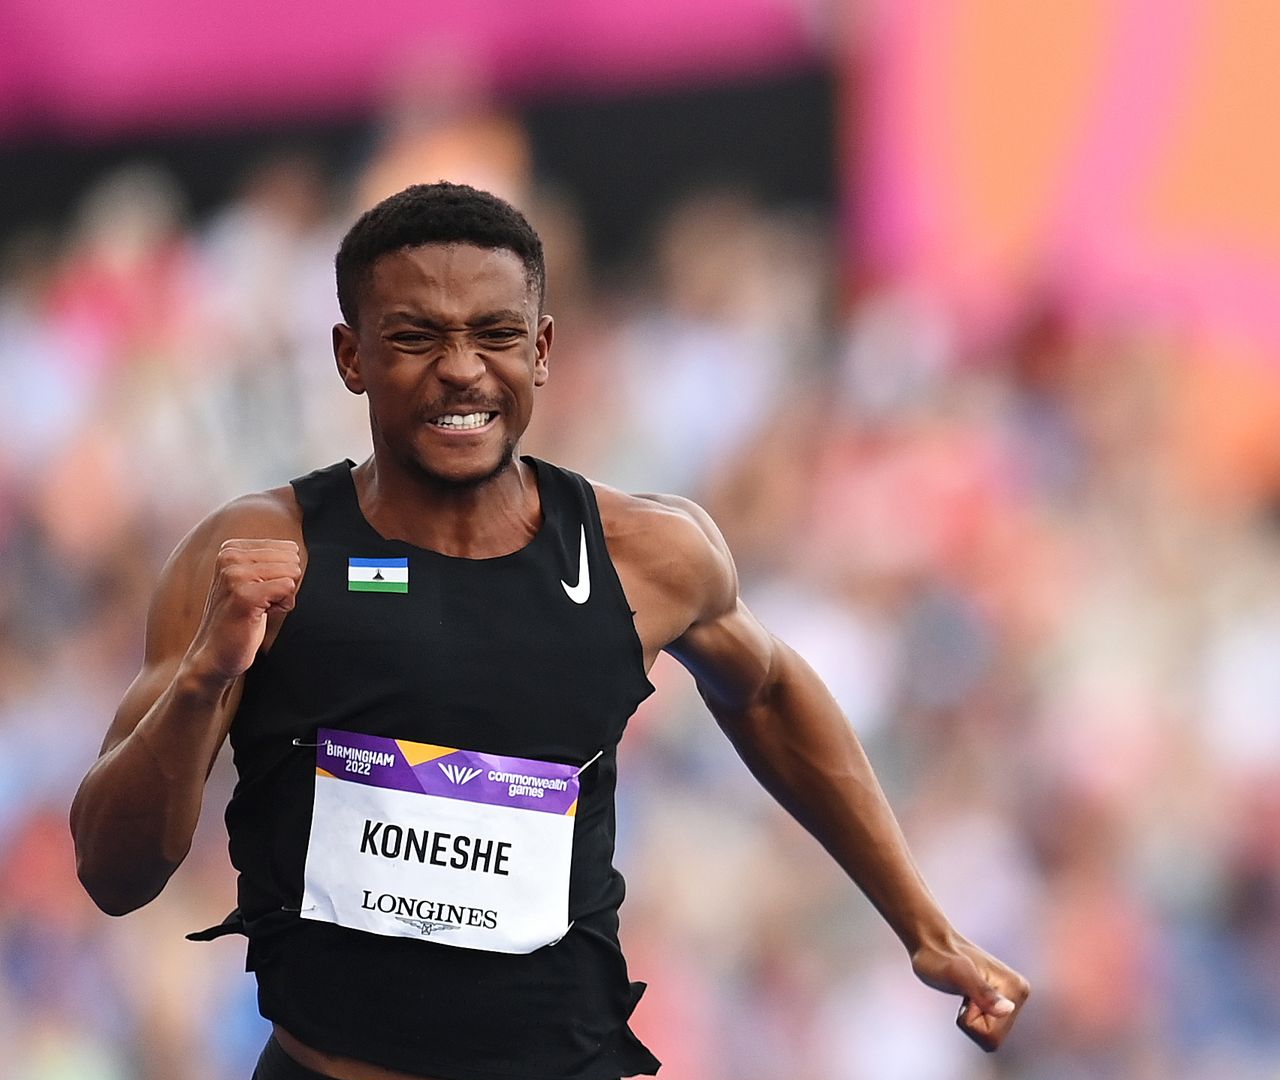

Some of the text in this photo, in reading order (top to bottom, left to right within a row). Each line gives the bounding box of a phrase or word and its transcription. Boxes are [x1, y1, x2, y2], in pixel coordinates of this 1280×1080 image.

[326, 744, 394, 767] BIRMINGHAM
[345, 759, 371, 776] 2022
[488, 770, 568, 791] commonwealth
[508, 784, 544, 798] games
[359, 819, 512, 876] KONESHE
[361, 890, 498, 929] LONGINES
